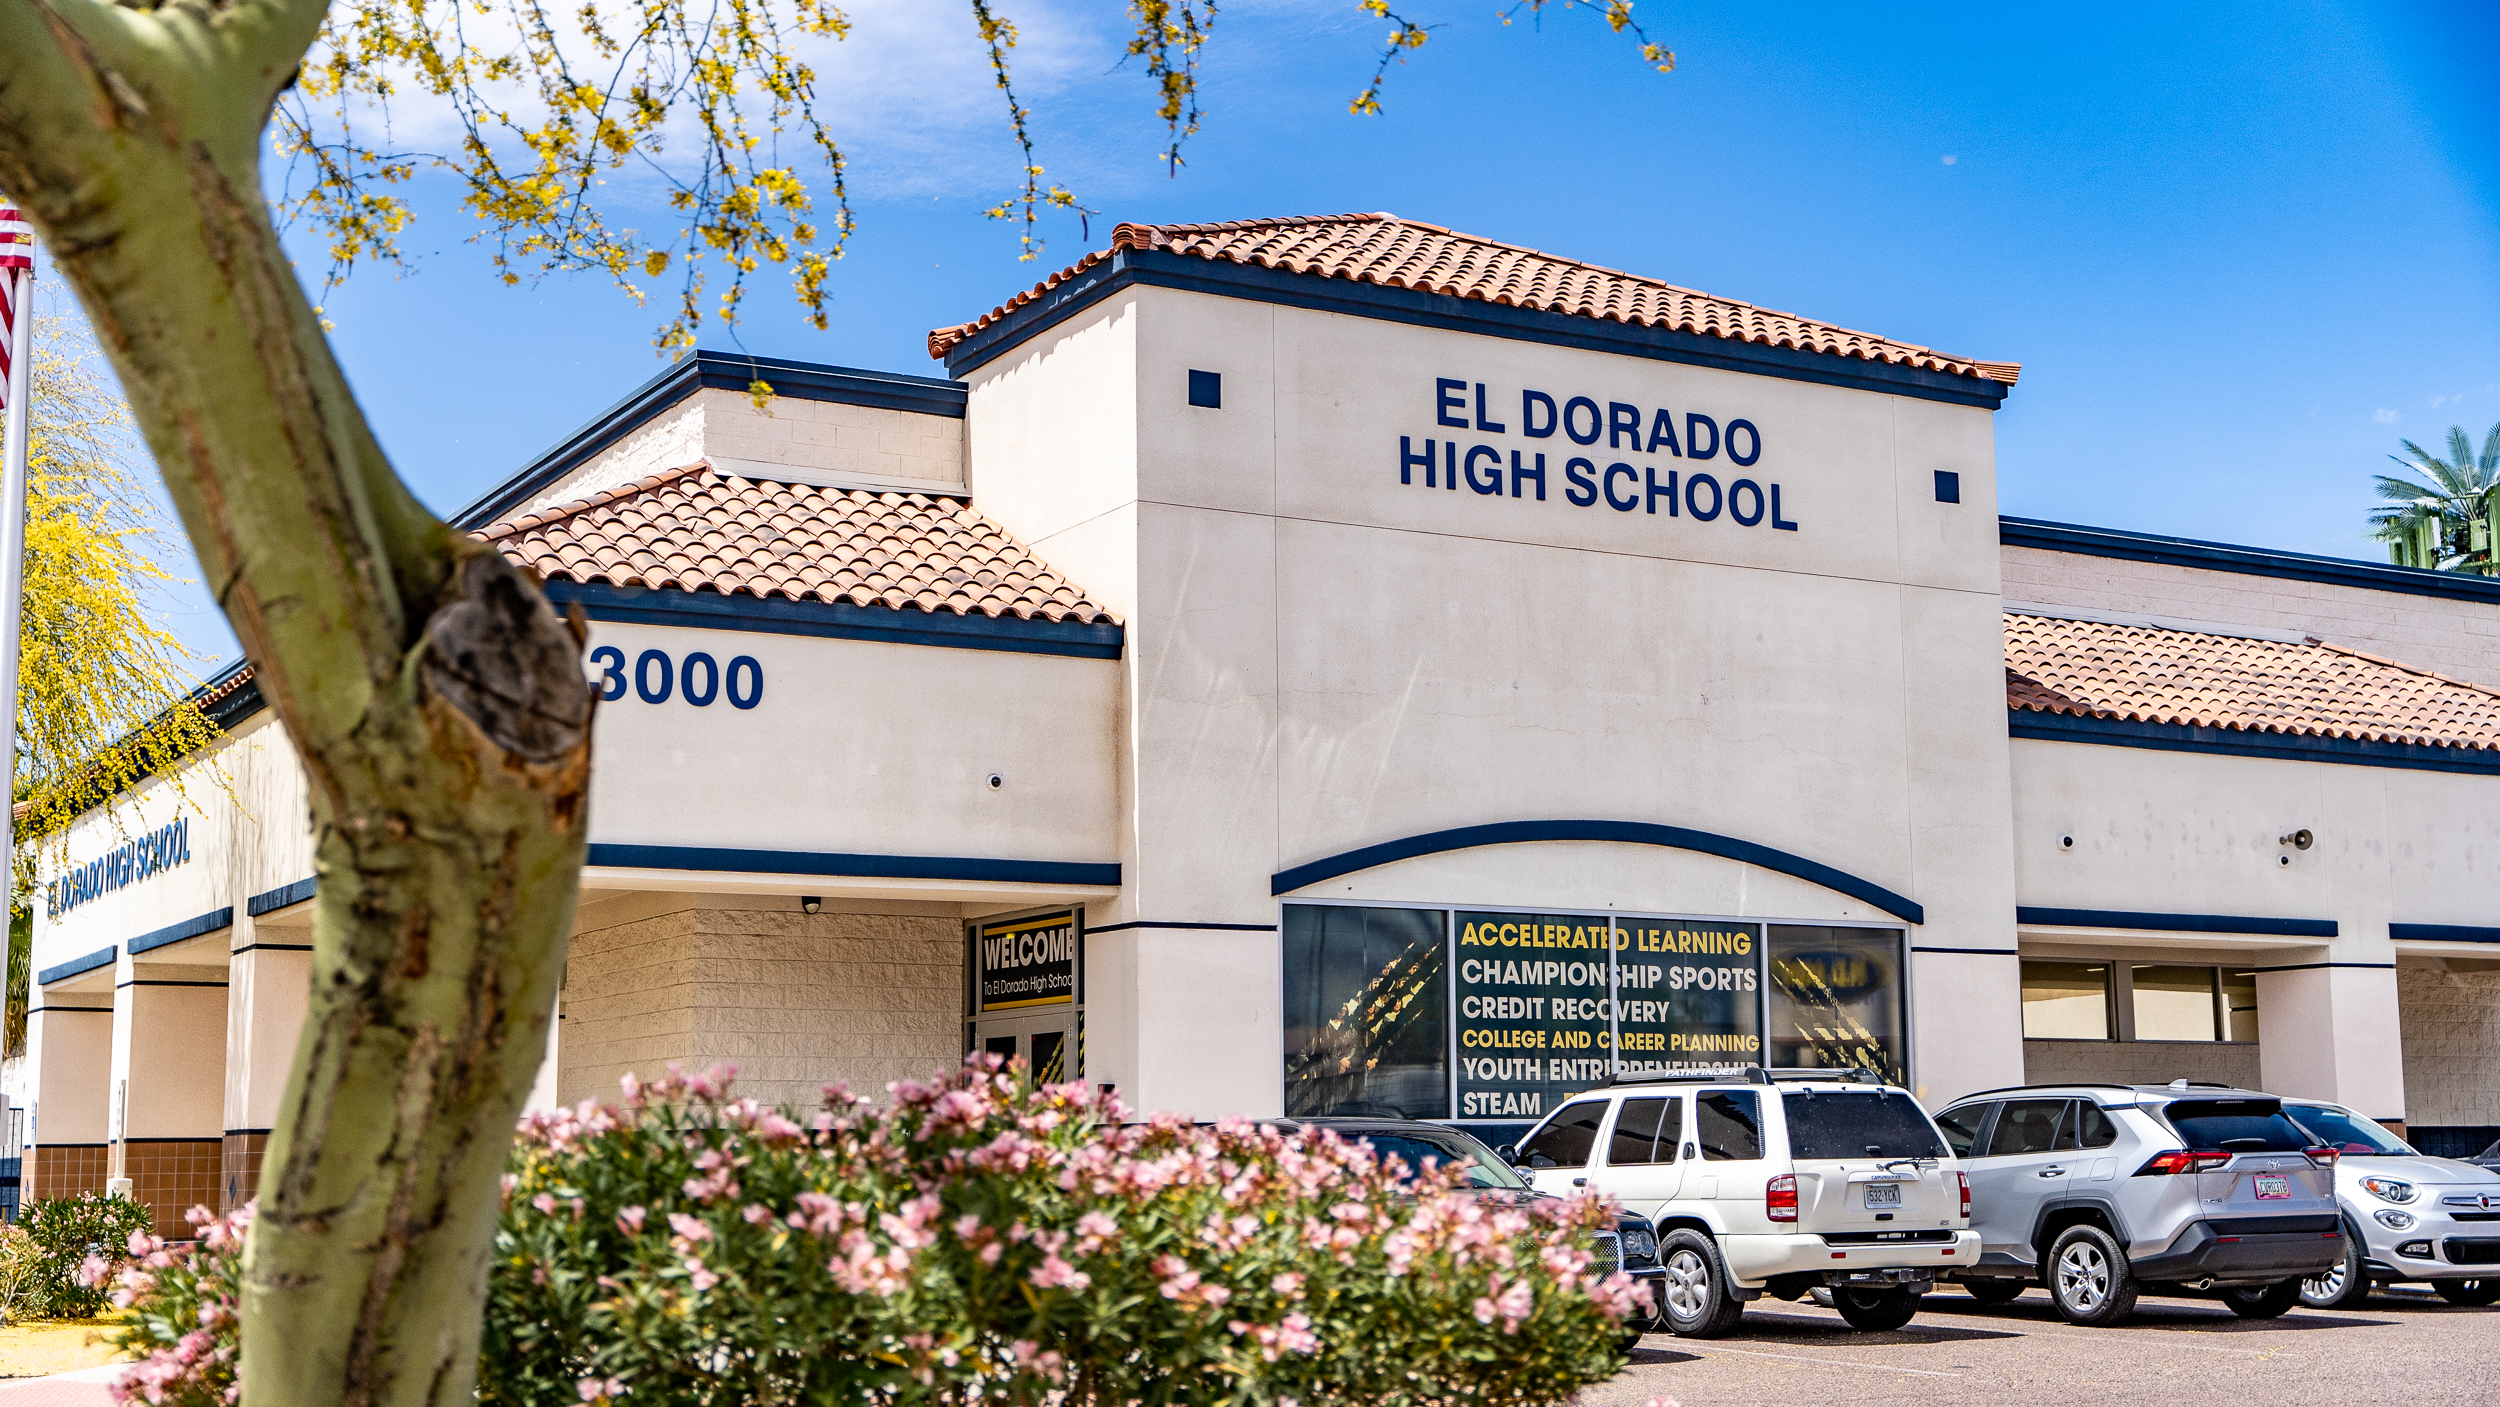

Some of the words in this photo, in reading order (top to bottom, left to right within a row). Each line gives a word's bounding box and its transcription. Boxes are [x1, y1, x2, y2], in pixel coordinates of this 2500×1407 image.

[1436, 377, 1505, 434] EL
[1522, 389, 1761, 467] DORADO
[1400, 435, 1546, 501] HIGH
[1565, 457, 1798, 532] SCHOOL
[588, 645, 764, 710] 3000
[60, 857, 104, 913] DORADO
[105, 841, 135, 893] HIGH
[136, 817, 190, 880] SCHOOL
[984, 927, 1073, 970] WELCOME
[1460, 922, 1630, 951] ACCELERATED
[1638, 929, 1752, 956] LEARNING
[984, 982, 992, 995] To
[994, 980, 999, 994] El
[1000, 977, 1029, 994] Dorado
[1030, 974, 1047, 994] High
[1048, 973, 1073, 989] Schoo
[1461, 959, 1663, 989] CHAMPIONSHIP
[1669, 966, 1758, 992] SPORTS
[1462, 995, 1545, 1020] CREDIT
[1551, 998, 1670, 1023] RECOVERY
[1462, 1029, 1546, 1049] COLLEGE
[1551, 1030, 1592, 1050] AND
[1596, 1031, 1666, 1051] CAREER
[1670, 1034, 1760, 1052] PLANNING
[1463, 1057, 1541, 1081] YOUTH
[1664, 1068, 1739, 1077] PATHFINDER
[1463, 1092, 1541, 1116] STEAM
